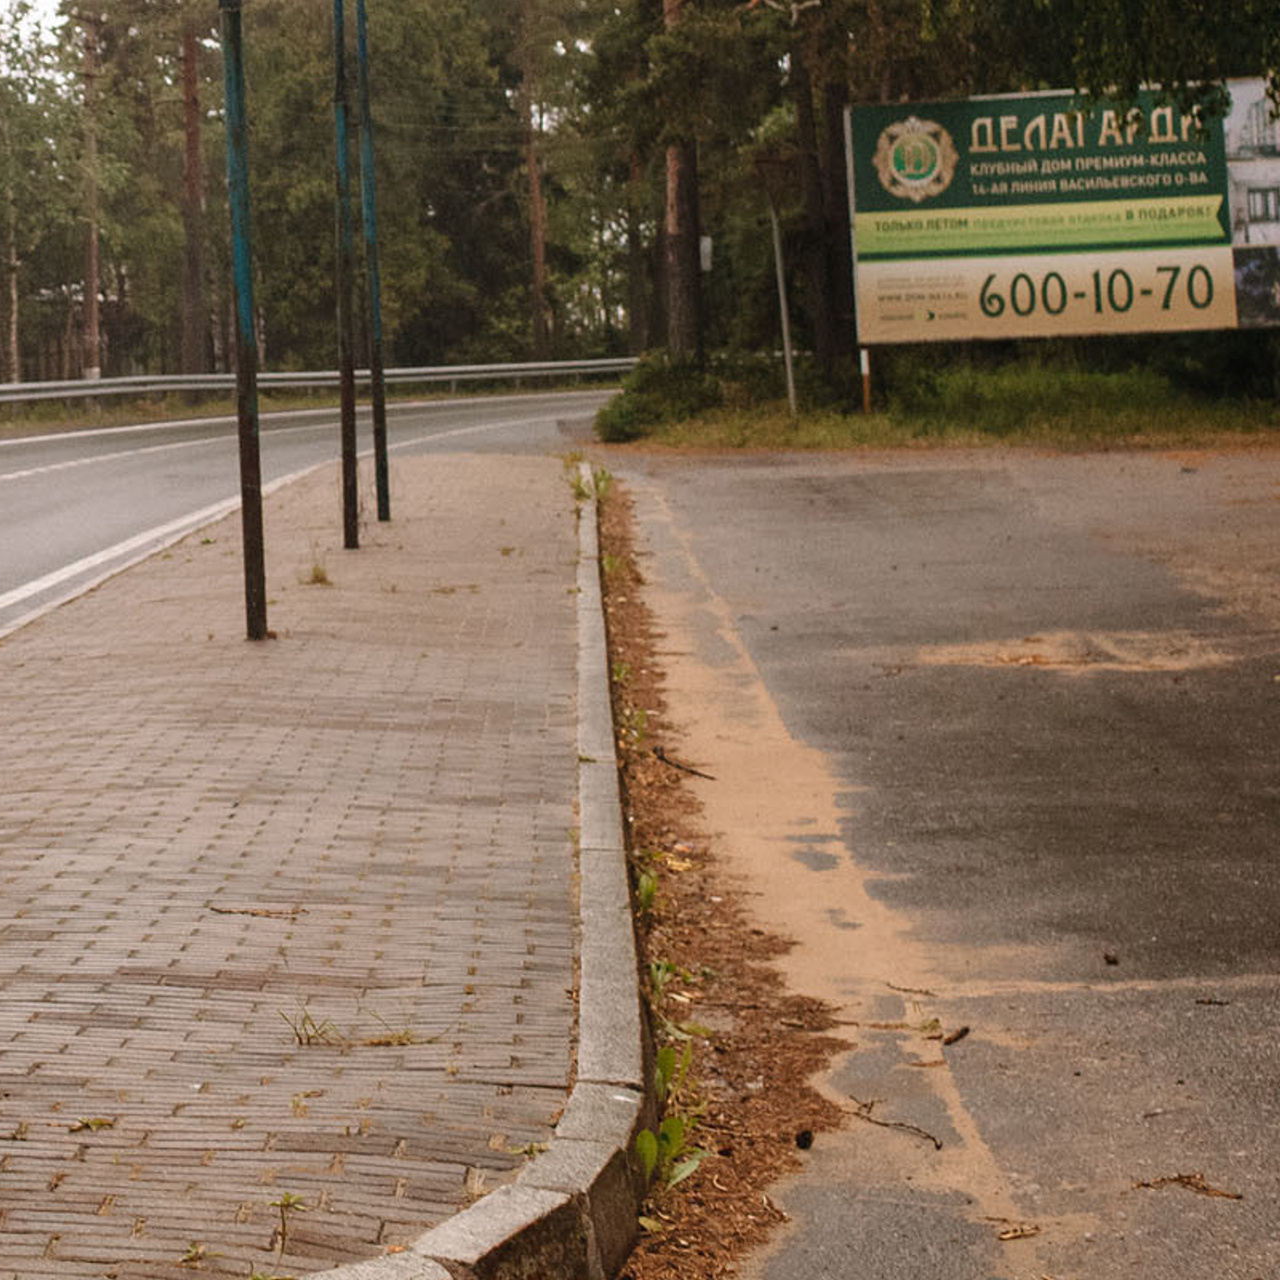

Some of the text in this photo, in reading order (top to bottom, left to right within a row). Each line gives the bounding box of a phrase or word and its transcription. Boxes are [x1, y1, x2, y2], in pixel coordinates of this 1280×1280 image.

[970, 151, 1207, 176] КЛУБНЫЙ ДОМ ПРЕМИУМ-КЛАССА
[1011, 179, 1057, 194] ЛИНИЯ
[979, 264, 1214, 318] 600-10-70
